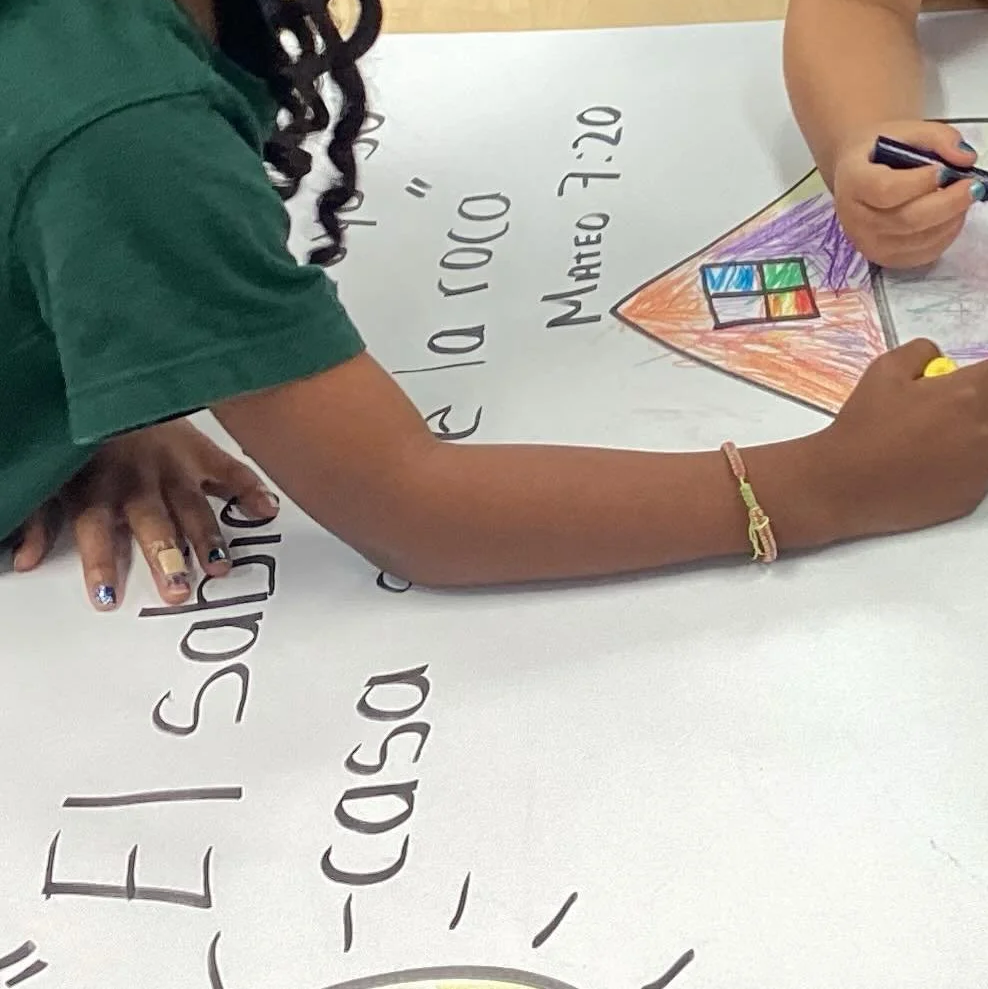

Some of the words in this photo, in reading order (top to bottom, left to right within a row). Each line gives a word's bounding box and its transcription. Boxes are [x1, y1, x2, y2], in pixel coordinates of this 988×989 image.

[557, 105, 623, 198] 7:20
[391, 324, 487, 374] la
[320, 663, 431, 886] casa
